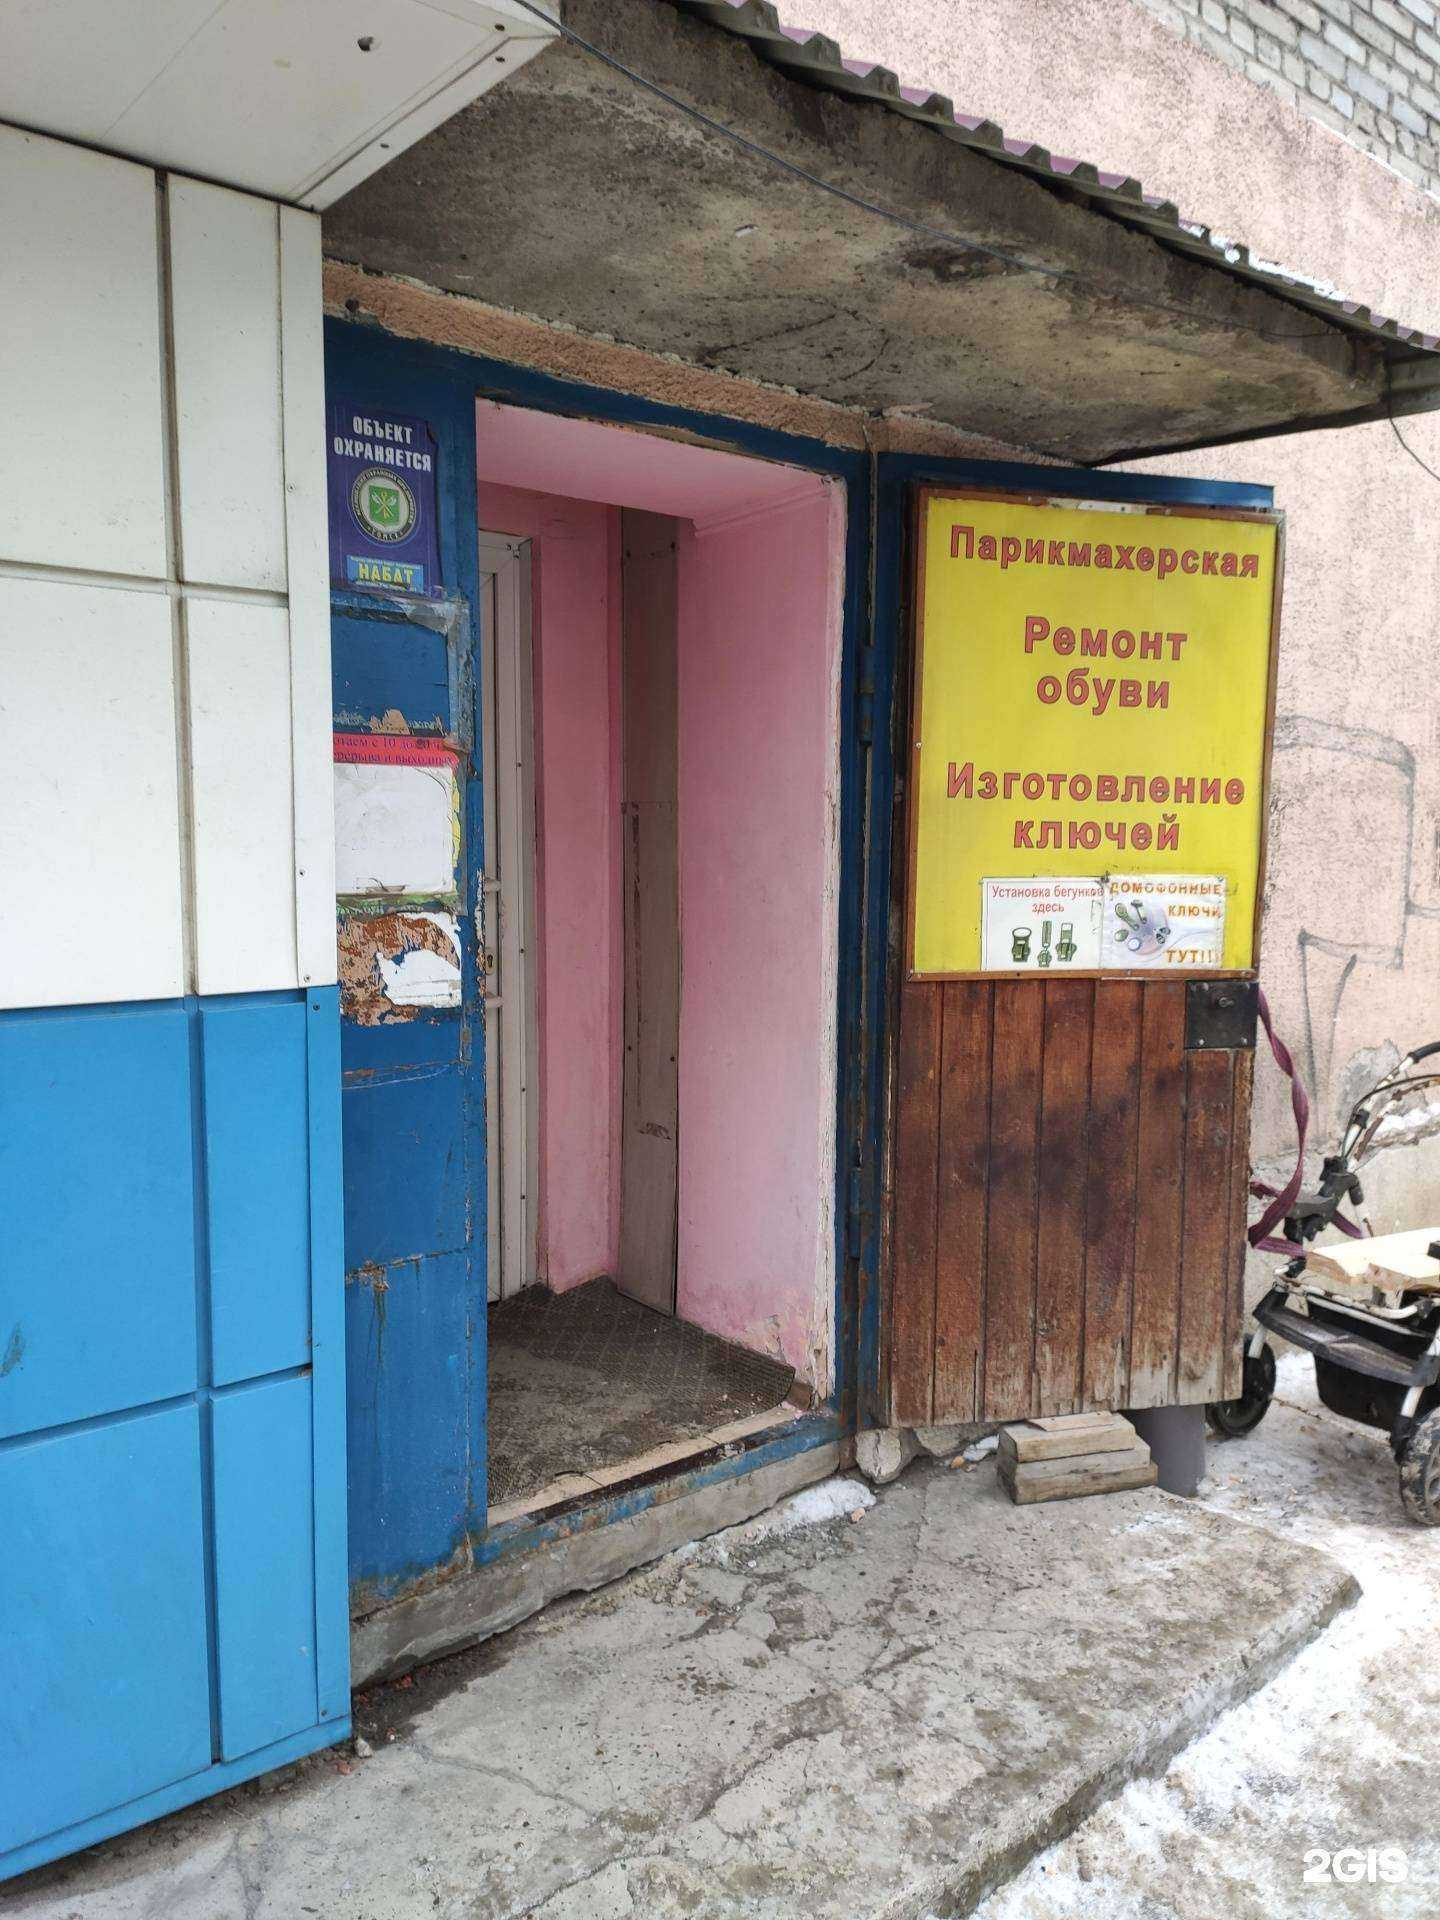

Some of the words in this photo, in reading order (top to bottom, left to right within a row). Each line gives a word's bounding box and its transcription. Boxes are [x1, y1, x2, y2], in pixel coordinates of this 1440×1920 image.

[352, 416, 413, 444] ОБЪЕКТ
[333, 437, 431, 472] ОХРАНЯЕТСЯ
[950, 525, 1259, 580] Парикмахерская
[358, 563, 414, 585] НАБАТ
[1024, 616, 1188, 661] Ремонт
[1036, 668, 1170, 716] обуви
[947, 762, 1245, 805] Изготовление
[1013, 813, 1180, 851] ключей
[992, 885, 1050, 898] Установка
[1054, 884, 1104, 900] бегунков
[1109, 882, 1221, 895] ДОМОФОННЫЕ
[1031, 903, 1065, 914] здесь
